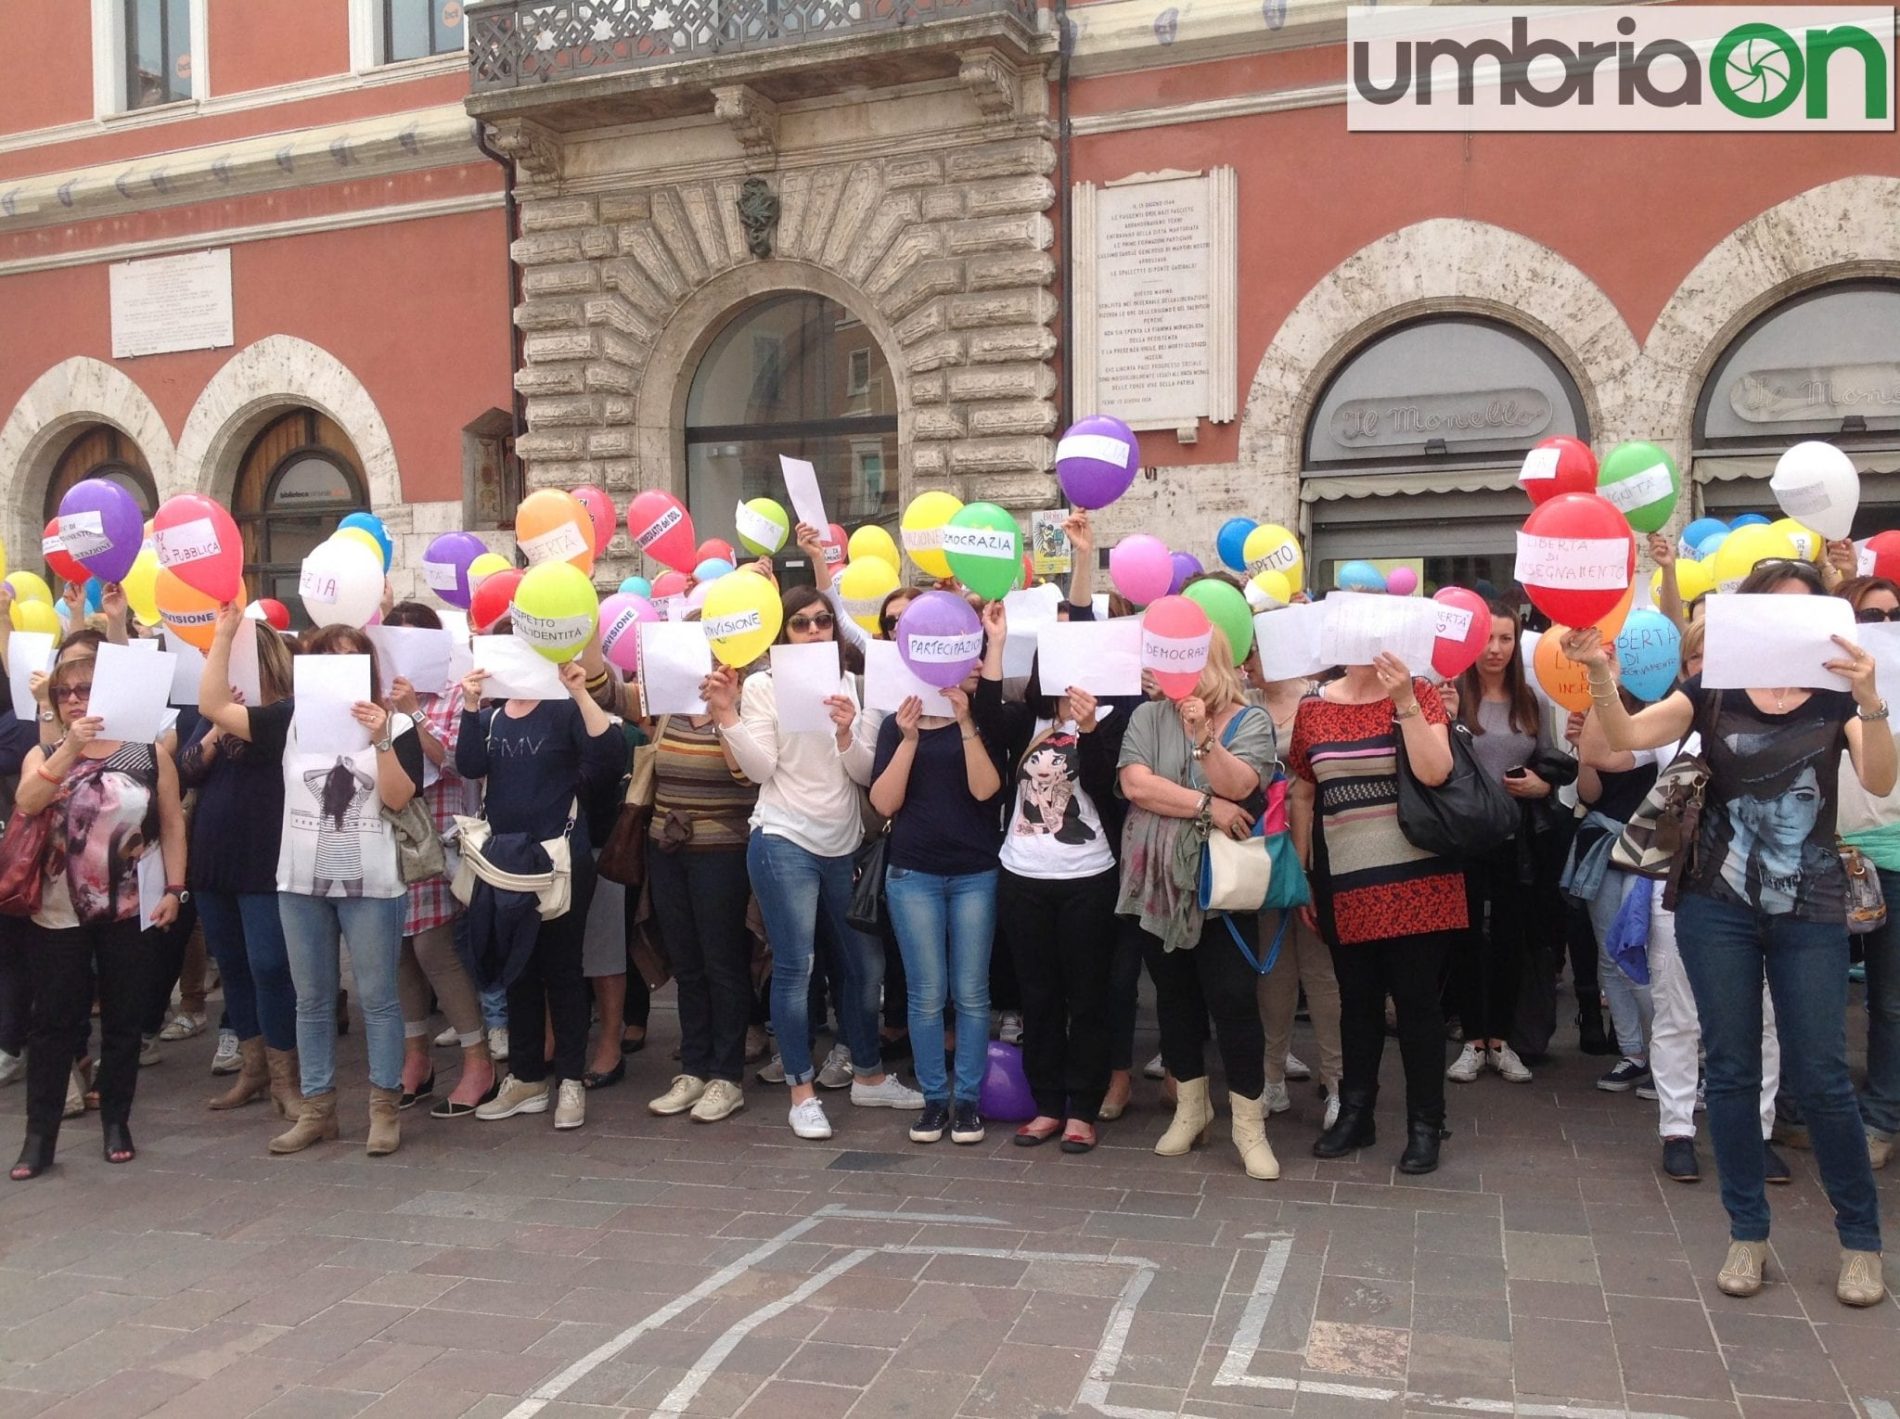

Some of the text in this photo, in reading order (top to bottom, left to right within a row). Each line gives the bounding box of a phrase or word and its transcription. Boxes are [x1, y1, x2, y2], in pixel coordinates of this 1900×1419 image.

[1385, 399, 1546, 434] Monello
[171, 541, 219, 563] PUBBLICA
[1146, 642, 1205, 661] DEMOCRAZ
